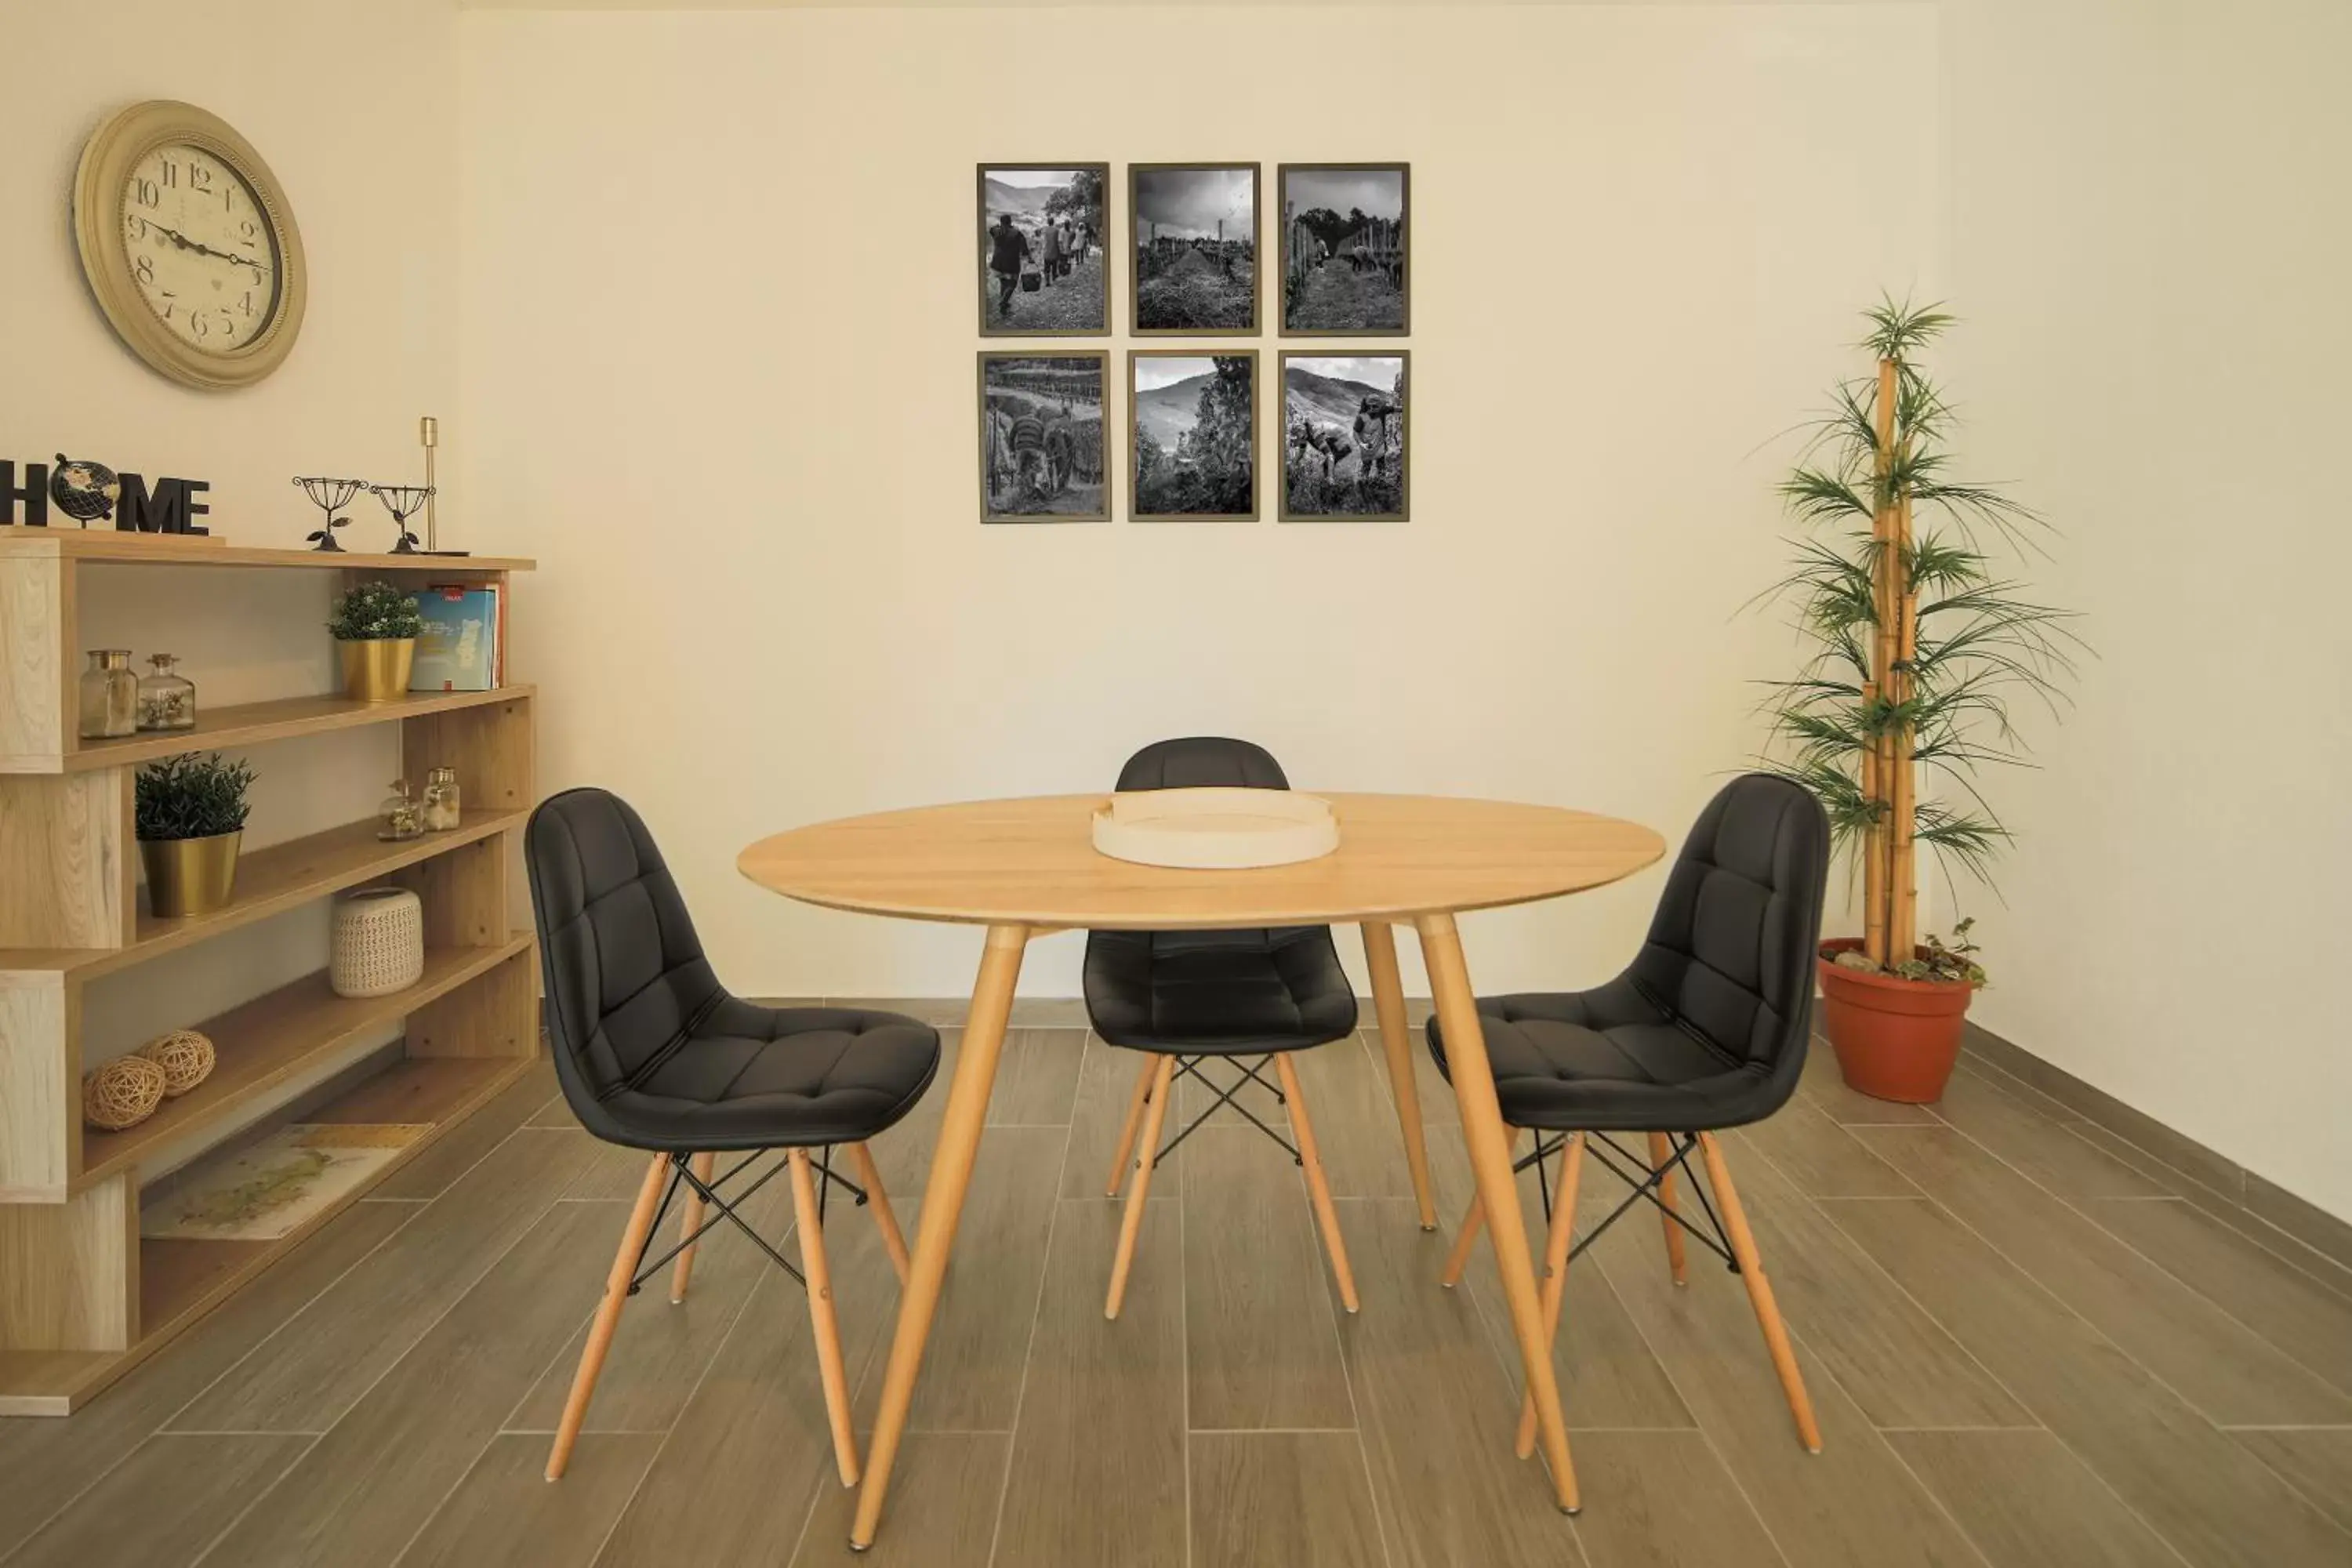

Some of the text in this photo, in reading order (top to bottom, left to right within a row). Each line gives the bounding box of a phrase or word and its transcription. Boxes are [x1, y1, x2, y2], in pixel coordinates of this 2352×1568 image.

[162, 160, 176, 189] 11
[189, 162, 212, 194] 12
[136, 178, 159, 210] 10
[224, 187, 230, 213] 1
[127, 213, 146, 239] 9
[240, 220, 256, 249] 2
[136, 254, 154, 285] 8
[162, 291, 176, 317] 7
[237, 291, 252, 318] 4
[191, 310, 209, 337] 6
[220, 307, 234, 335] 5
